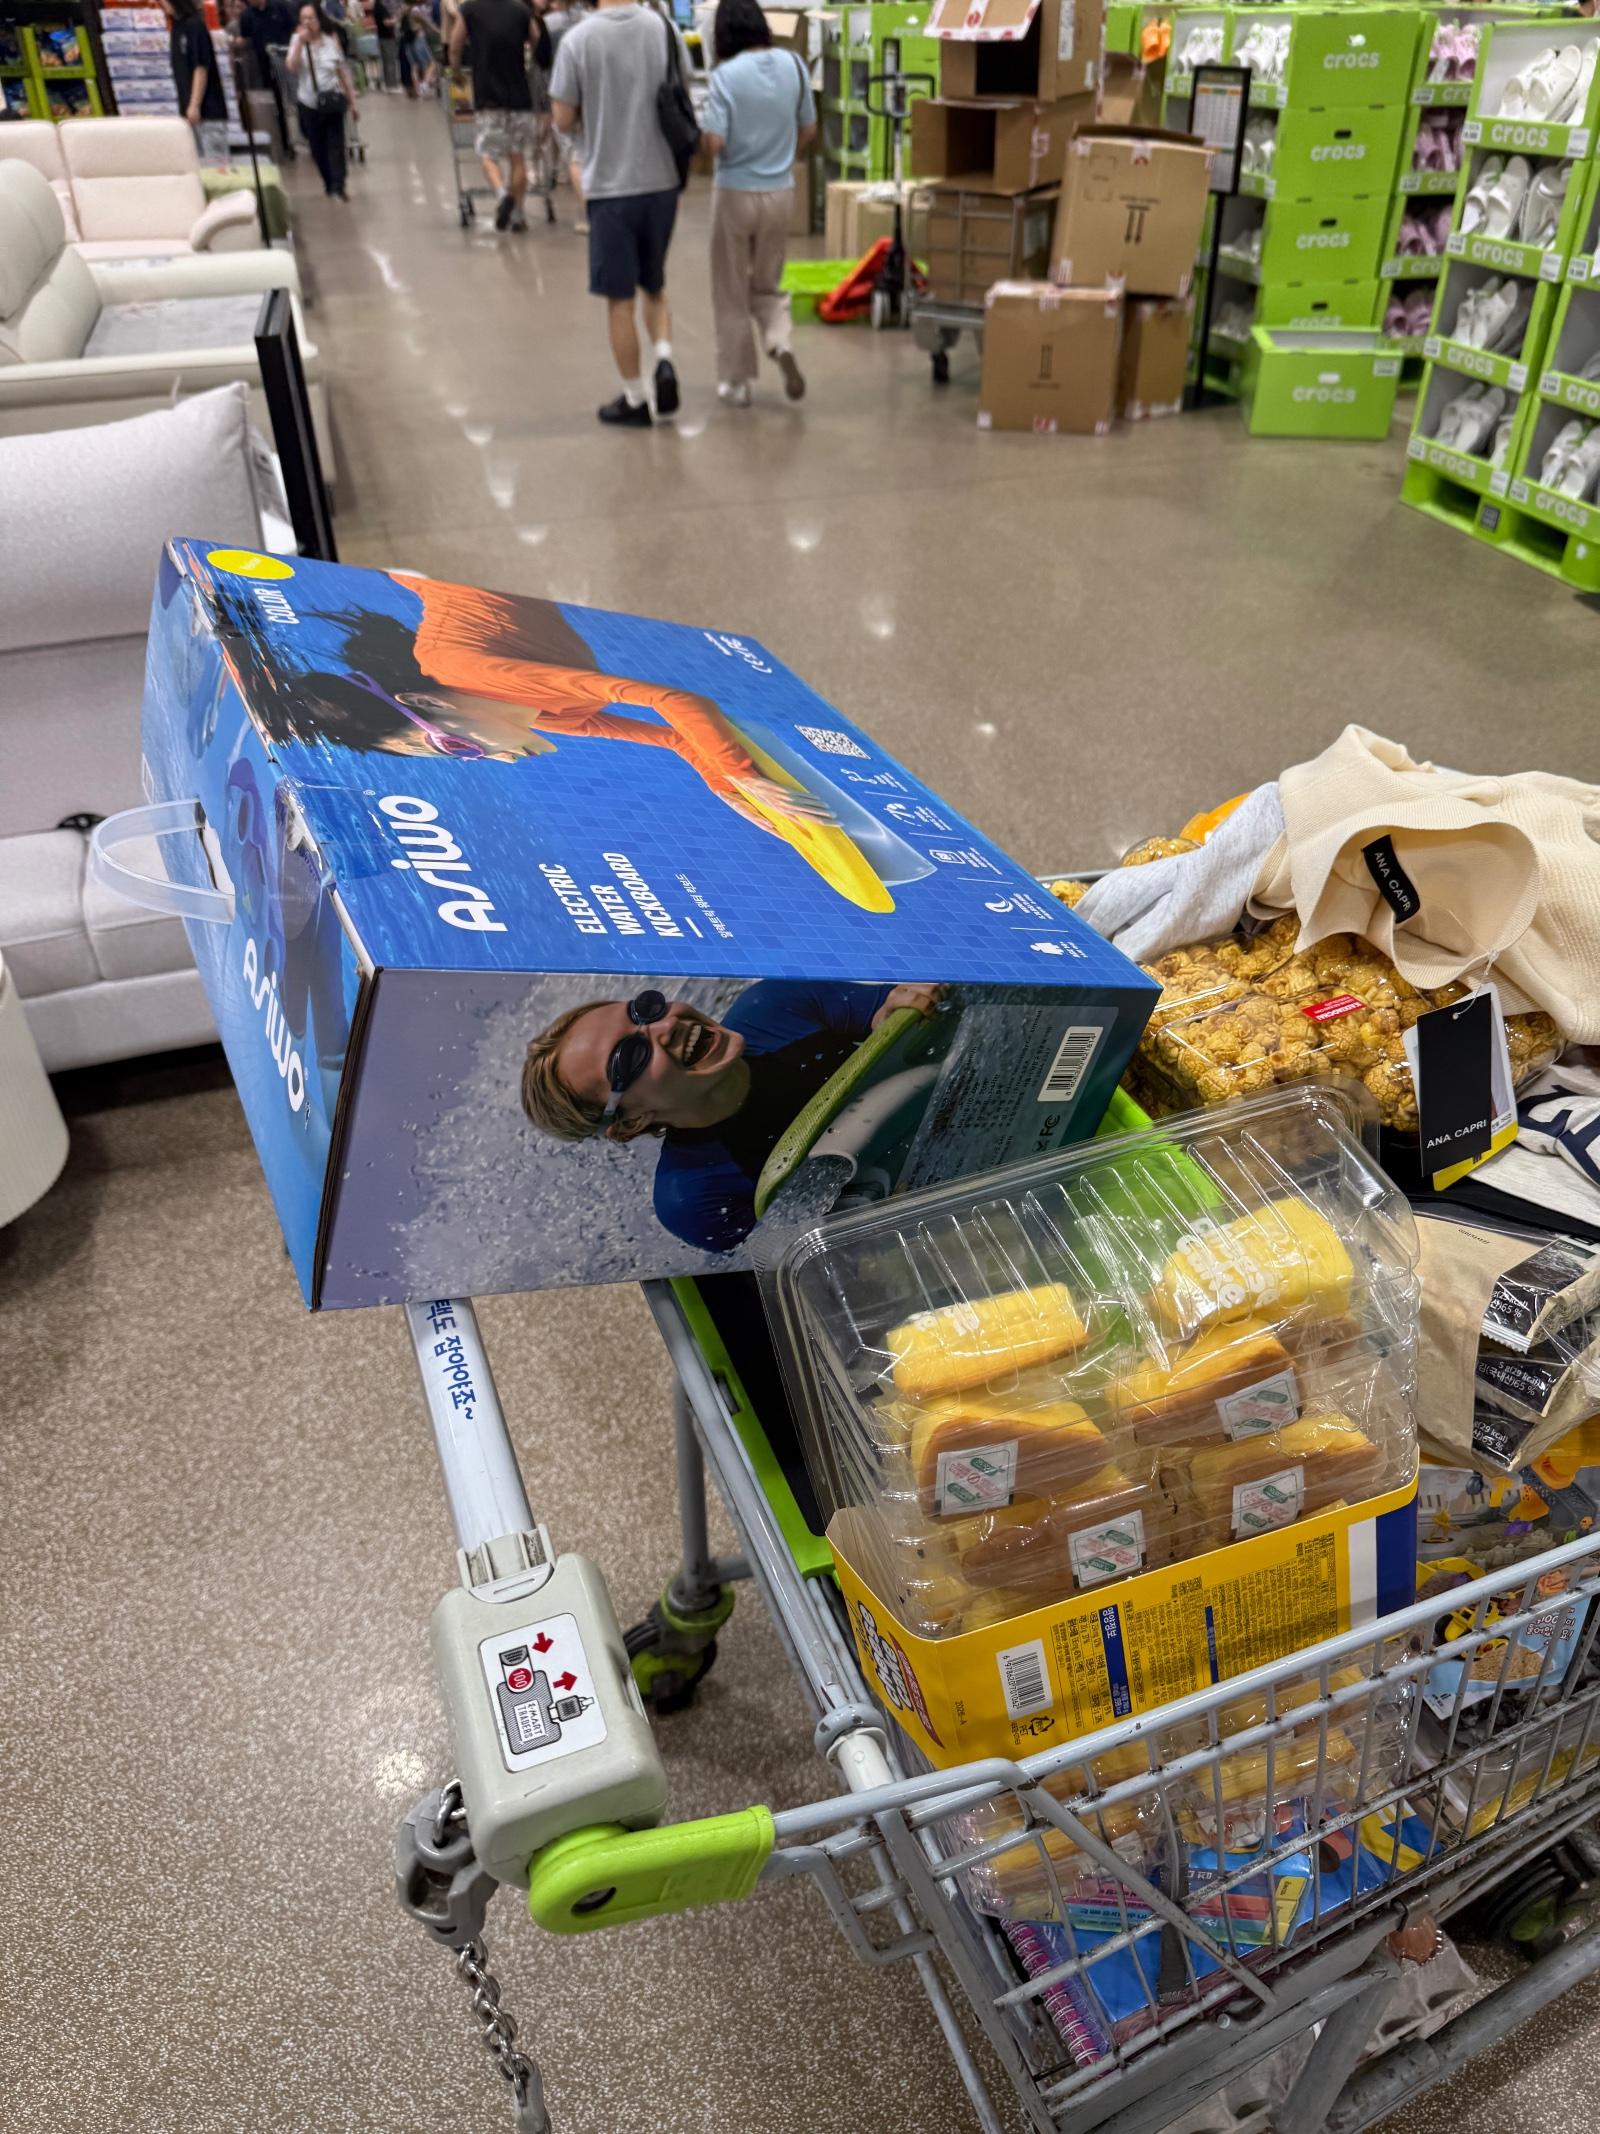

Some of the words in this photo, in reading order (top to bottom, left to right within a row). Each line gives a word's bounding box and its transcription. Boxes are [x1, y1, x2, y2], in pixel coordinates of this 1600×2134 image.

[1323, 52, 1380, 70] crocs
[1491, 124, 1549, 148] crocs
[1310, 143, 1366, 161] crocs
[1296, 231, 1350, 248] crocs
[1471, 242, 1524, 268] crocs
[1447, 346, 1494, 375] crocs
[1292, 386, 1357, 403] crocs
[1429, 448, 1476, 479] crocs
[1535, 495, 1588, 526] crocs
[265, 587, 300, 625] COLOR
[1374, 851, 1390, 878] ANA
[601, 852, 685, 938] KICKBOARD
[675, 873, 698, 895] 킥보드
[539, 863, 609, 935] ELECTRIC
[596, 883, 646, 936] WATER
[702, 908, 735, 940] 일렉트릭
[1426, 1129, 1451, 1149] ANA
[1454, 1119, 1487, 1137] CAPRI
[1515, 1308, 1523, 1318] %
[433, 1336, 476, 1420] 잡아야죠~
[1498, 1361, 1503, 1369] 5
[1522, 1371, 1541, 1387] kcal)
[1528, 1386, 1536, 1396] %
[1490, 1428, 1508, 1443] kcal)
[1495, 1442, 1504, 1451] %
[1102, 1606, 1118, 1639] 영양정보
[512, 1671, 528, 1688] 100
[517, 1706, 533, 1739] TRADERS
